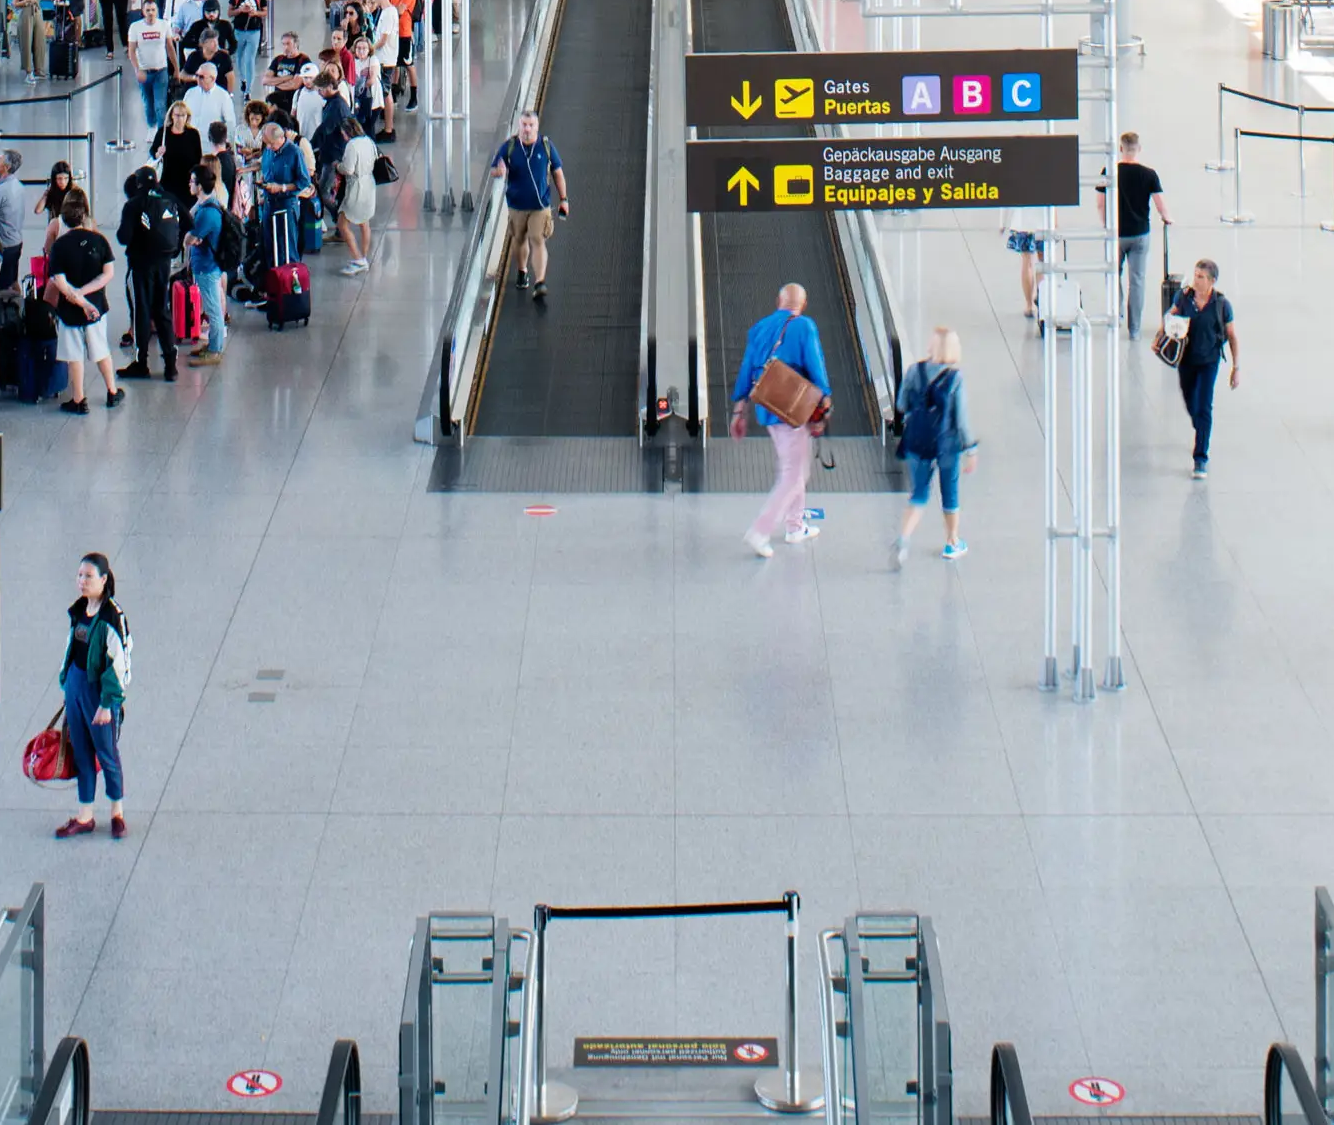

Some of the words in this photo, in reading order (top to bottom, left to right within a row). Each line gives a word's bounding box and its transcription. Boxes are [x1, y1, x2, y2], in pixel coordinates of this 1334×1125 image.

[823, 79, 870, 95] Gates
[910, 80, 933, 110] A
[962, 80, 983, 108] B
[1012, 80, 1032, 107] C
[824, 98, 891, 116] Puertas
[823, 146, 936, 165] Gepäckausgabe
[939, 145, 1002, 164] Ausgang
[823, 166, 890, 183] Baggage
[895, 165, 922, 180] and
[927, 165, 954, 180] exit
[824, 184, 916, 206] Equipajes
[923, 187, 934, 205] y
[940, 183, 1000, 200] Salida
[667, 1054, 709, 1062] Personal
